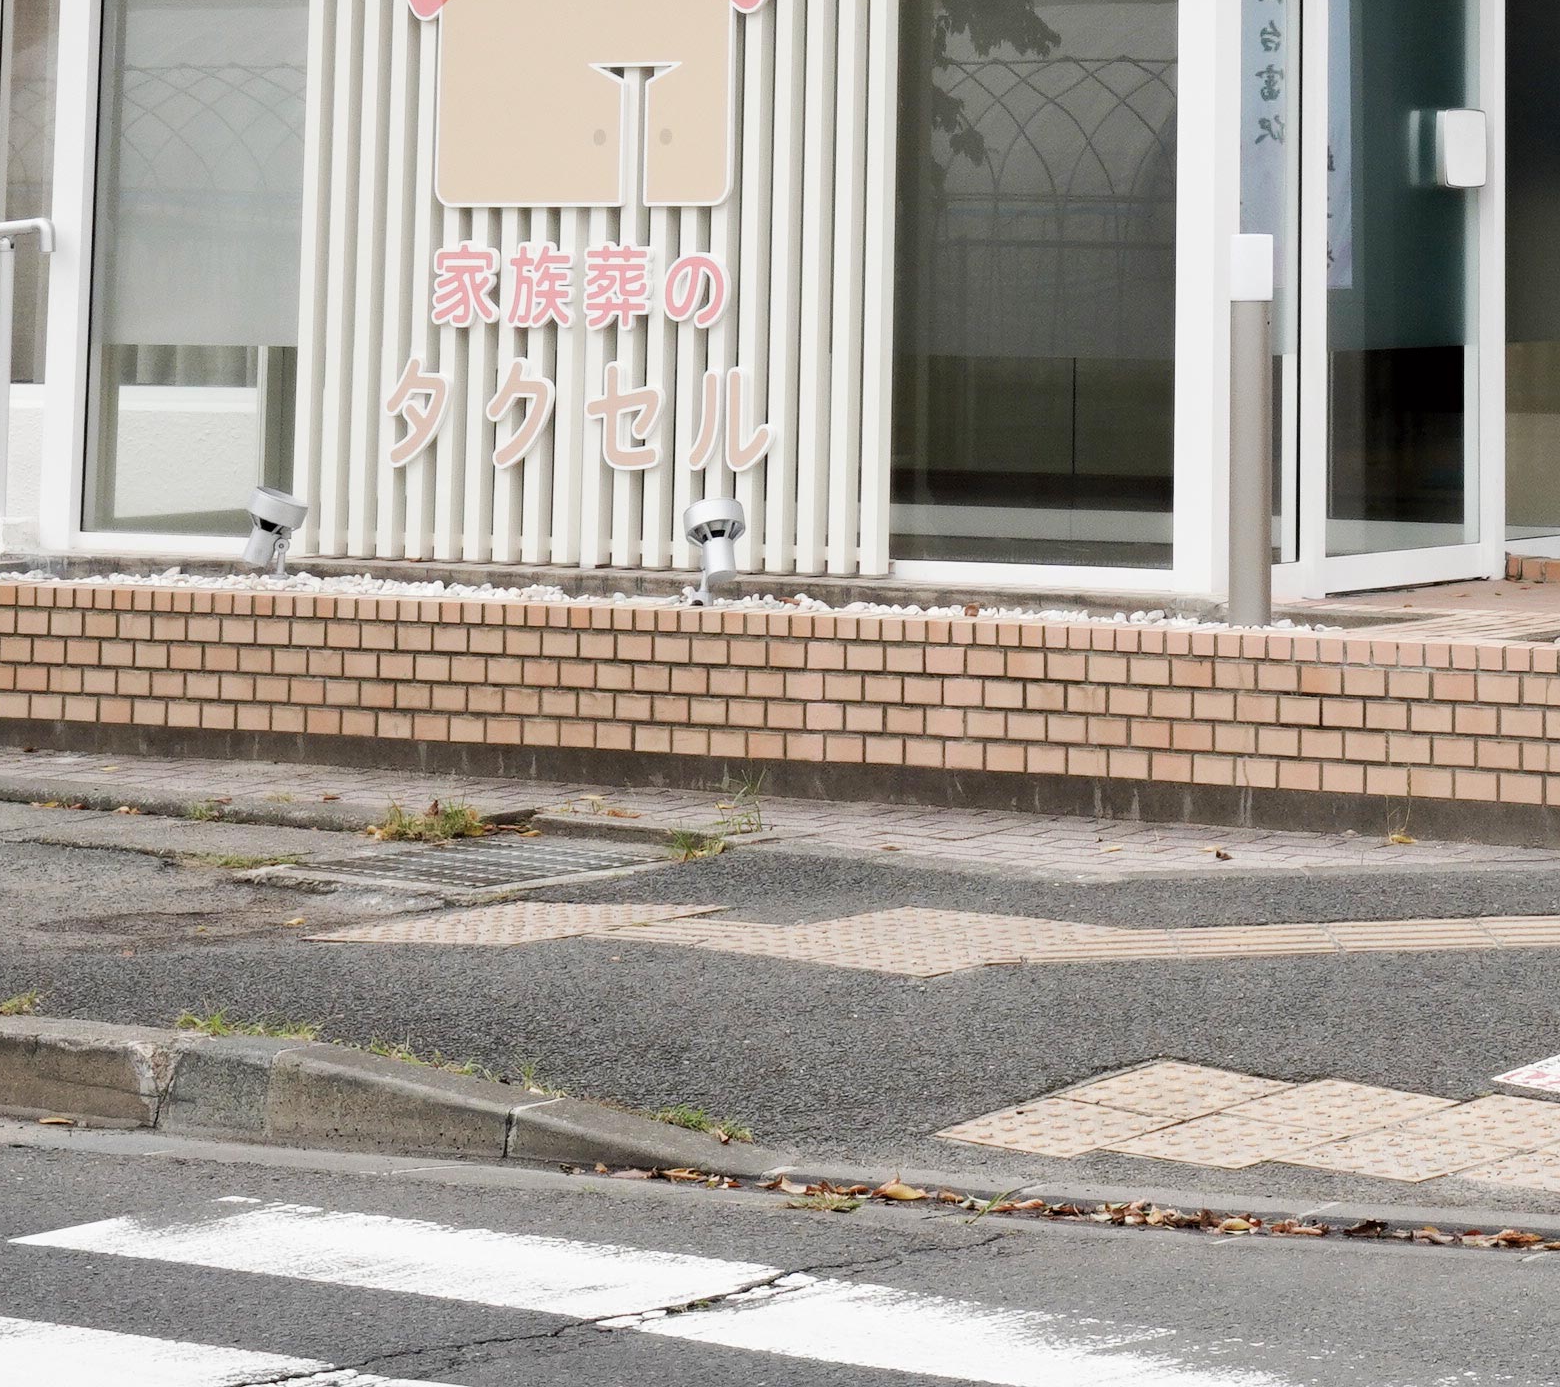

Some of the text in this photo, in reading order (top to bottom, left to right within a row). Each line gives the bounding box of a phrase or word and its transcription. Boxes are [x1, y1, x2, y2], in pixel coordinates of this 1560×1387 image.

[432, 243, 727, 328] 家族葬の
[386, 357, 773, 472] タクセル
